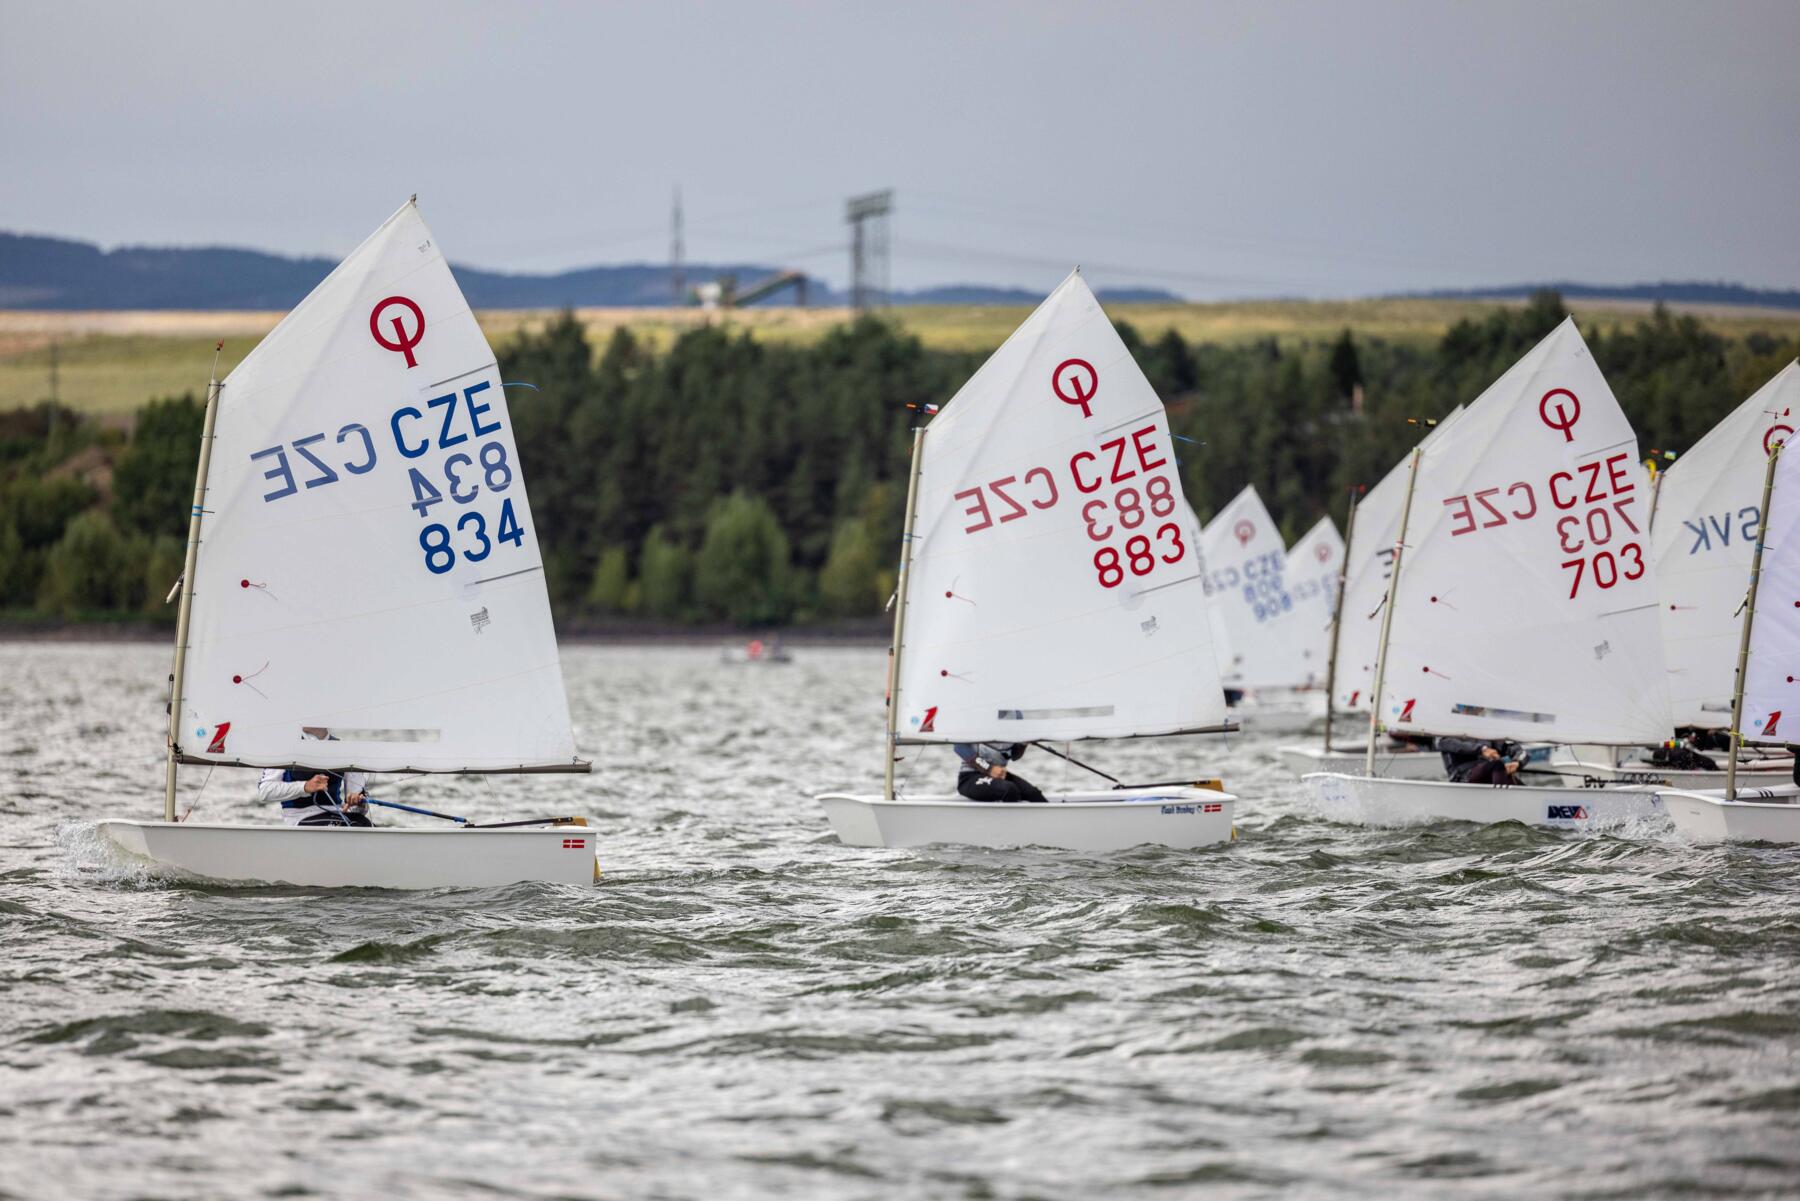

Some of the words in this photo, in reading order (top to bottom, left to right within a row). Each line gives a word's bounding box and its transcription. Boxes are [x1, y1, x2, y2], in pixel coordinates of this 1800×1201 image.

[390, 380, 502, 459] CZE
[1069, 424, 1168, 494] CZE
[1548, 452, 1635, 510] CZE
[419, 497, 525, 575] 834
[1093, 522, 1186, 589] 883
[1560, 542, 1646, 600] 703
